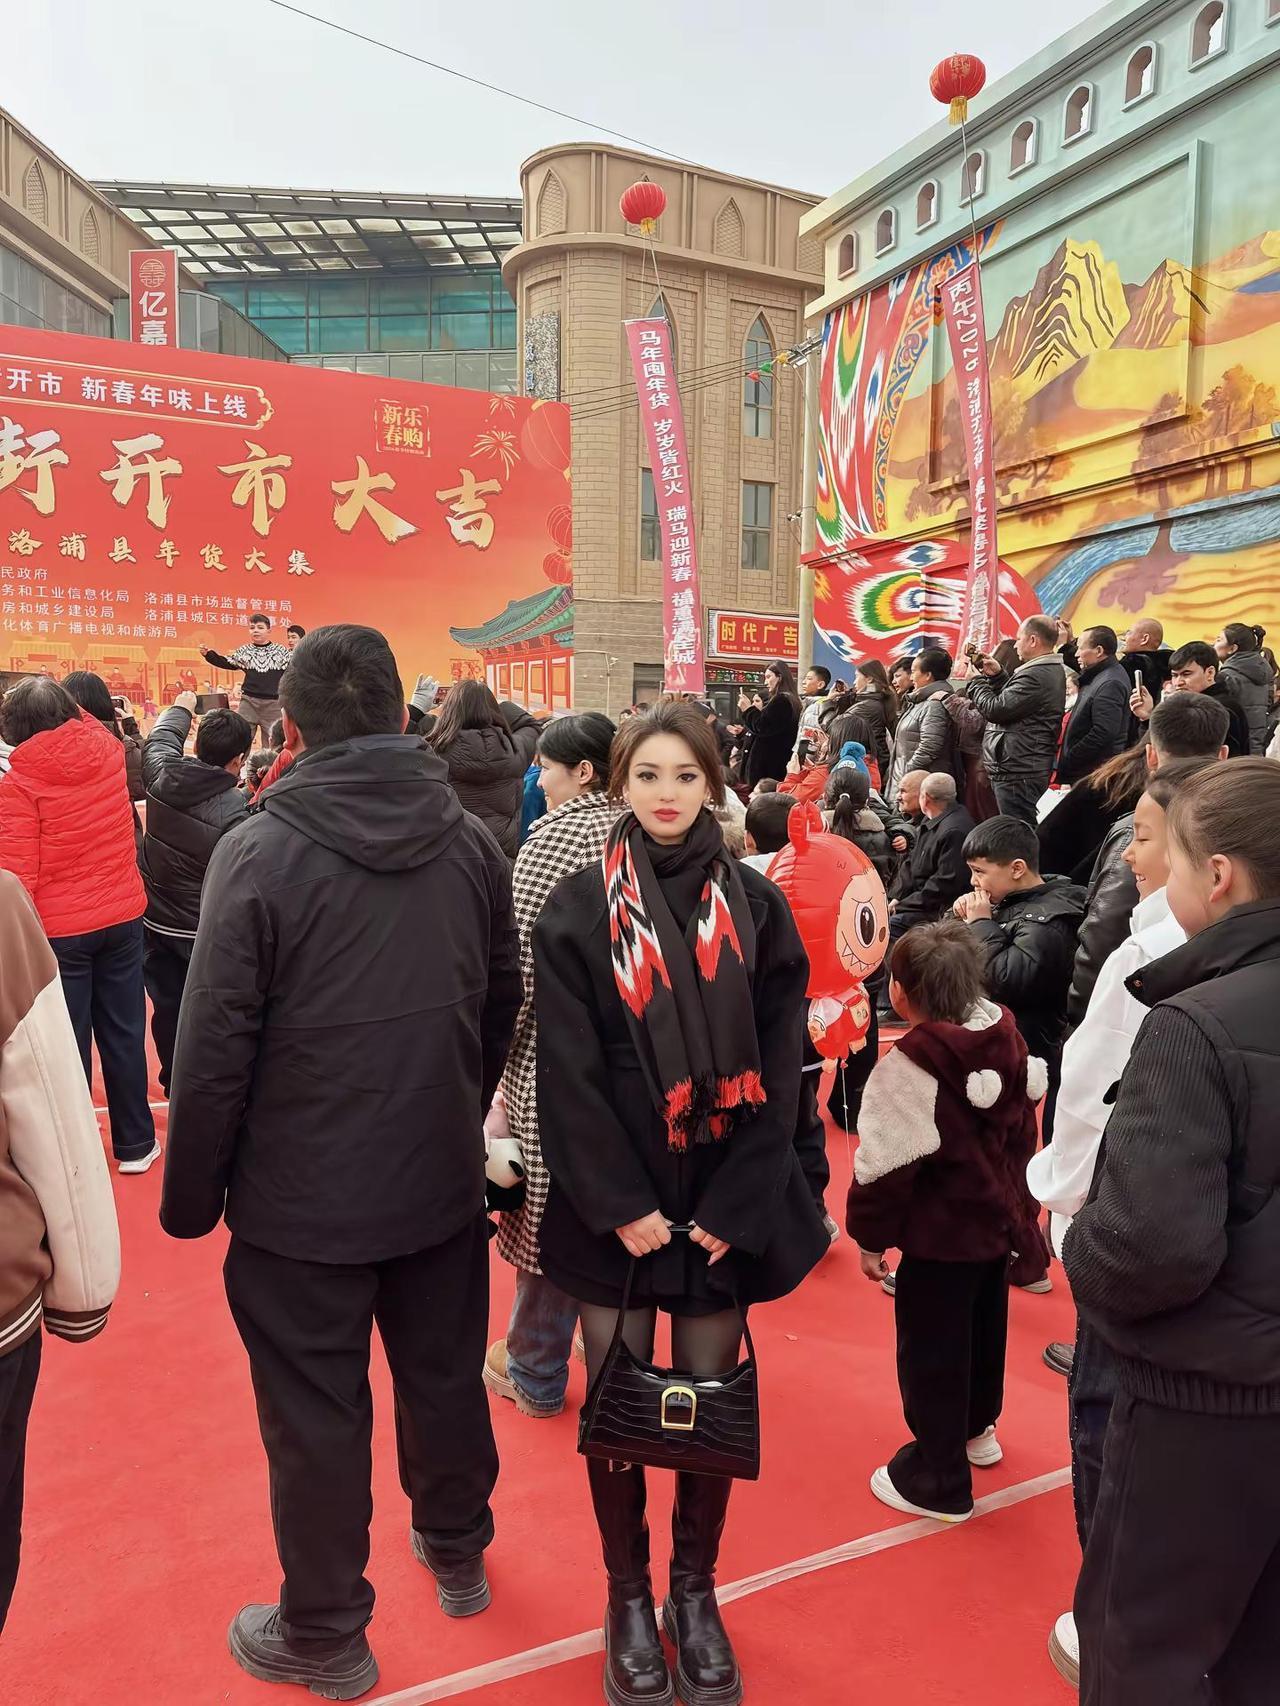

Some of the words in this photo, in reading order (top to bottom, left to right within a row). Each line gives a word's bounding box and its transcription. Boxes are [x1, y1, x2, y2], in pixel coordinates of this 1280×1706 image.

[639, 330, 670, 408] 马年囤年货
[0, 367, 63, 396] 开市
[81, 376, 248, 419] 新春年味上线
[653, 417, 684, 496] 岁岁皆红火
[7, 528, 315, 577] 洛浦县年货大集
[666, 505, 693, 582] 瑞马迎新春
[1, 566, 48, 581] 民政府
[1, 584, 130, 603] 务和工业信息化局
[144, 591, 293, 613] 洛浦县市场监督管理局
[2, 601, 115, 619] 房和城乡建设局
[144, 608, 292, 628] 洛浦县城区街道事处
[3, 618, 178, 639] 化体育广播电视和旅游局
[721, 620, 798, 647] 时代广告
